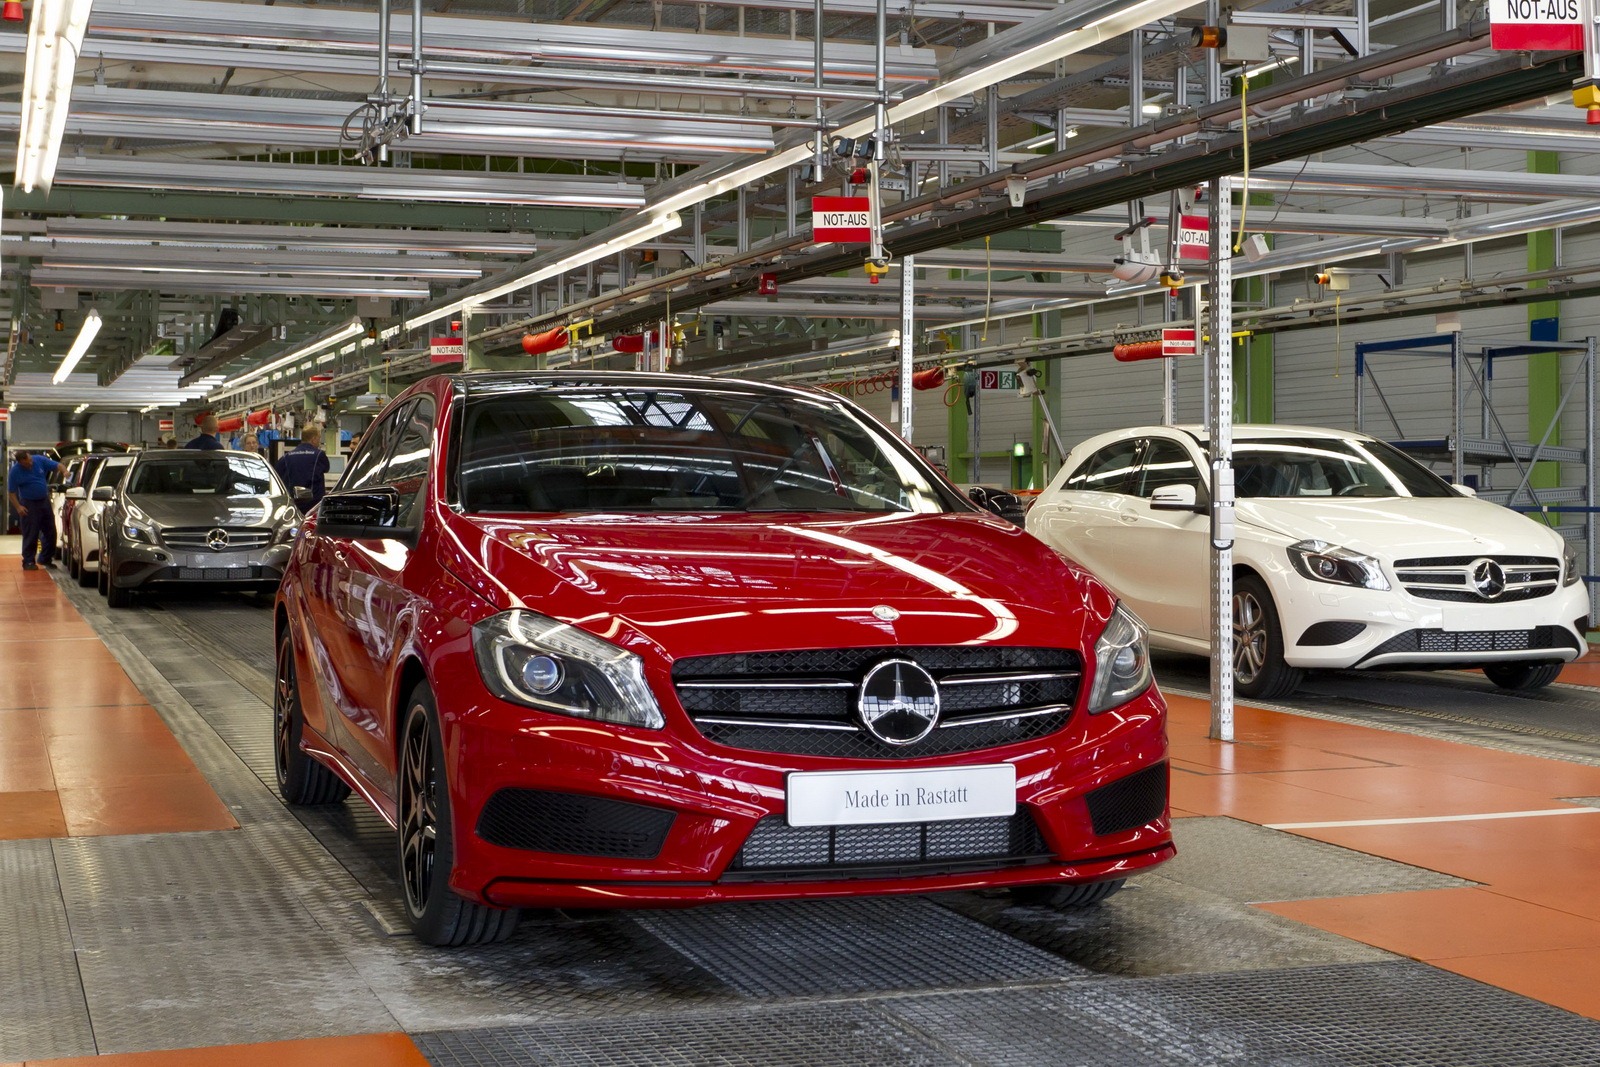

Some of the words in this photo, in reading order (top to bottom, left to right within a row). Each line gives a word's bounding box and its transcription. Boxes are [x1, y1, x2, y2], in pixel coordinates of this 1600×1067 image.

[1507, 0, 1578, 20] NOT-AUS
[823, 213, 867, 226] NOT-AUS
[1180, 230, 1210, 245] NOT-AU
[436, 346, 462, 354] NOT-AUS
[844, 789, 890, 809] Made
[895, 788, 910, 807] in
[916, 786, 969, 806] Rastatt
